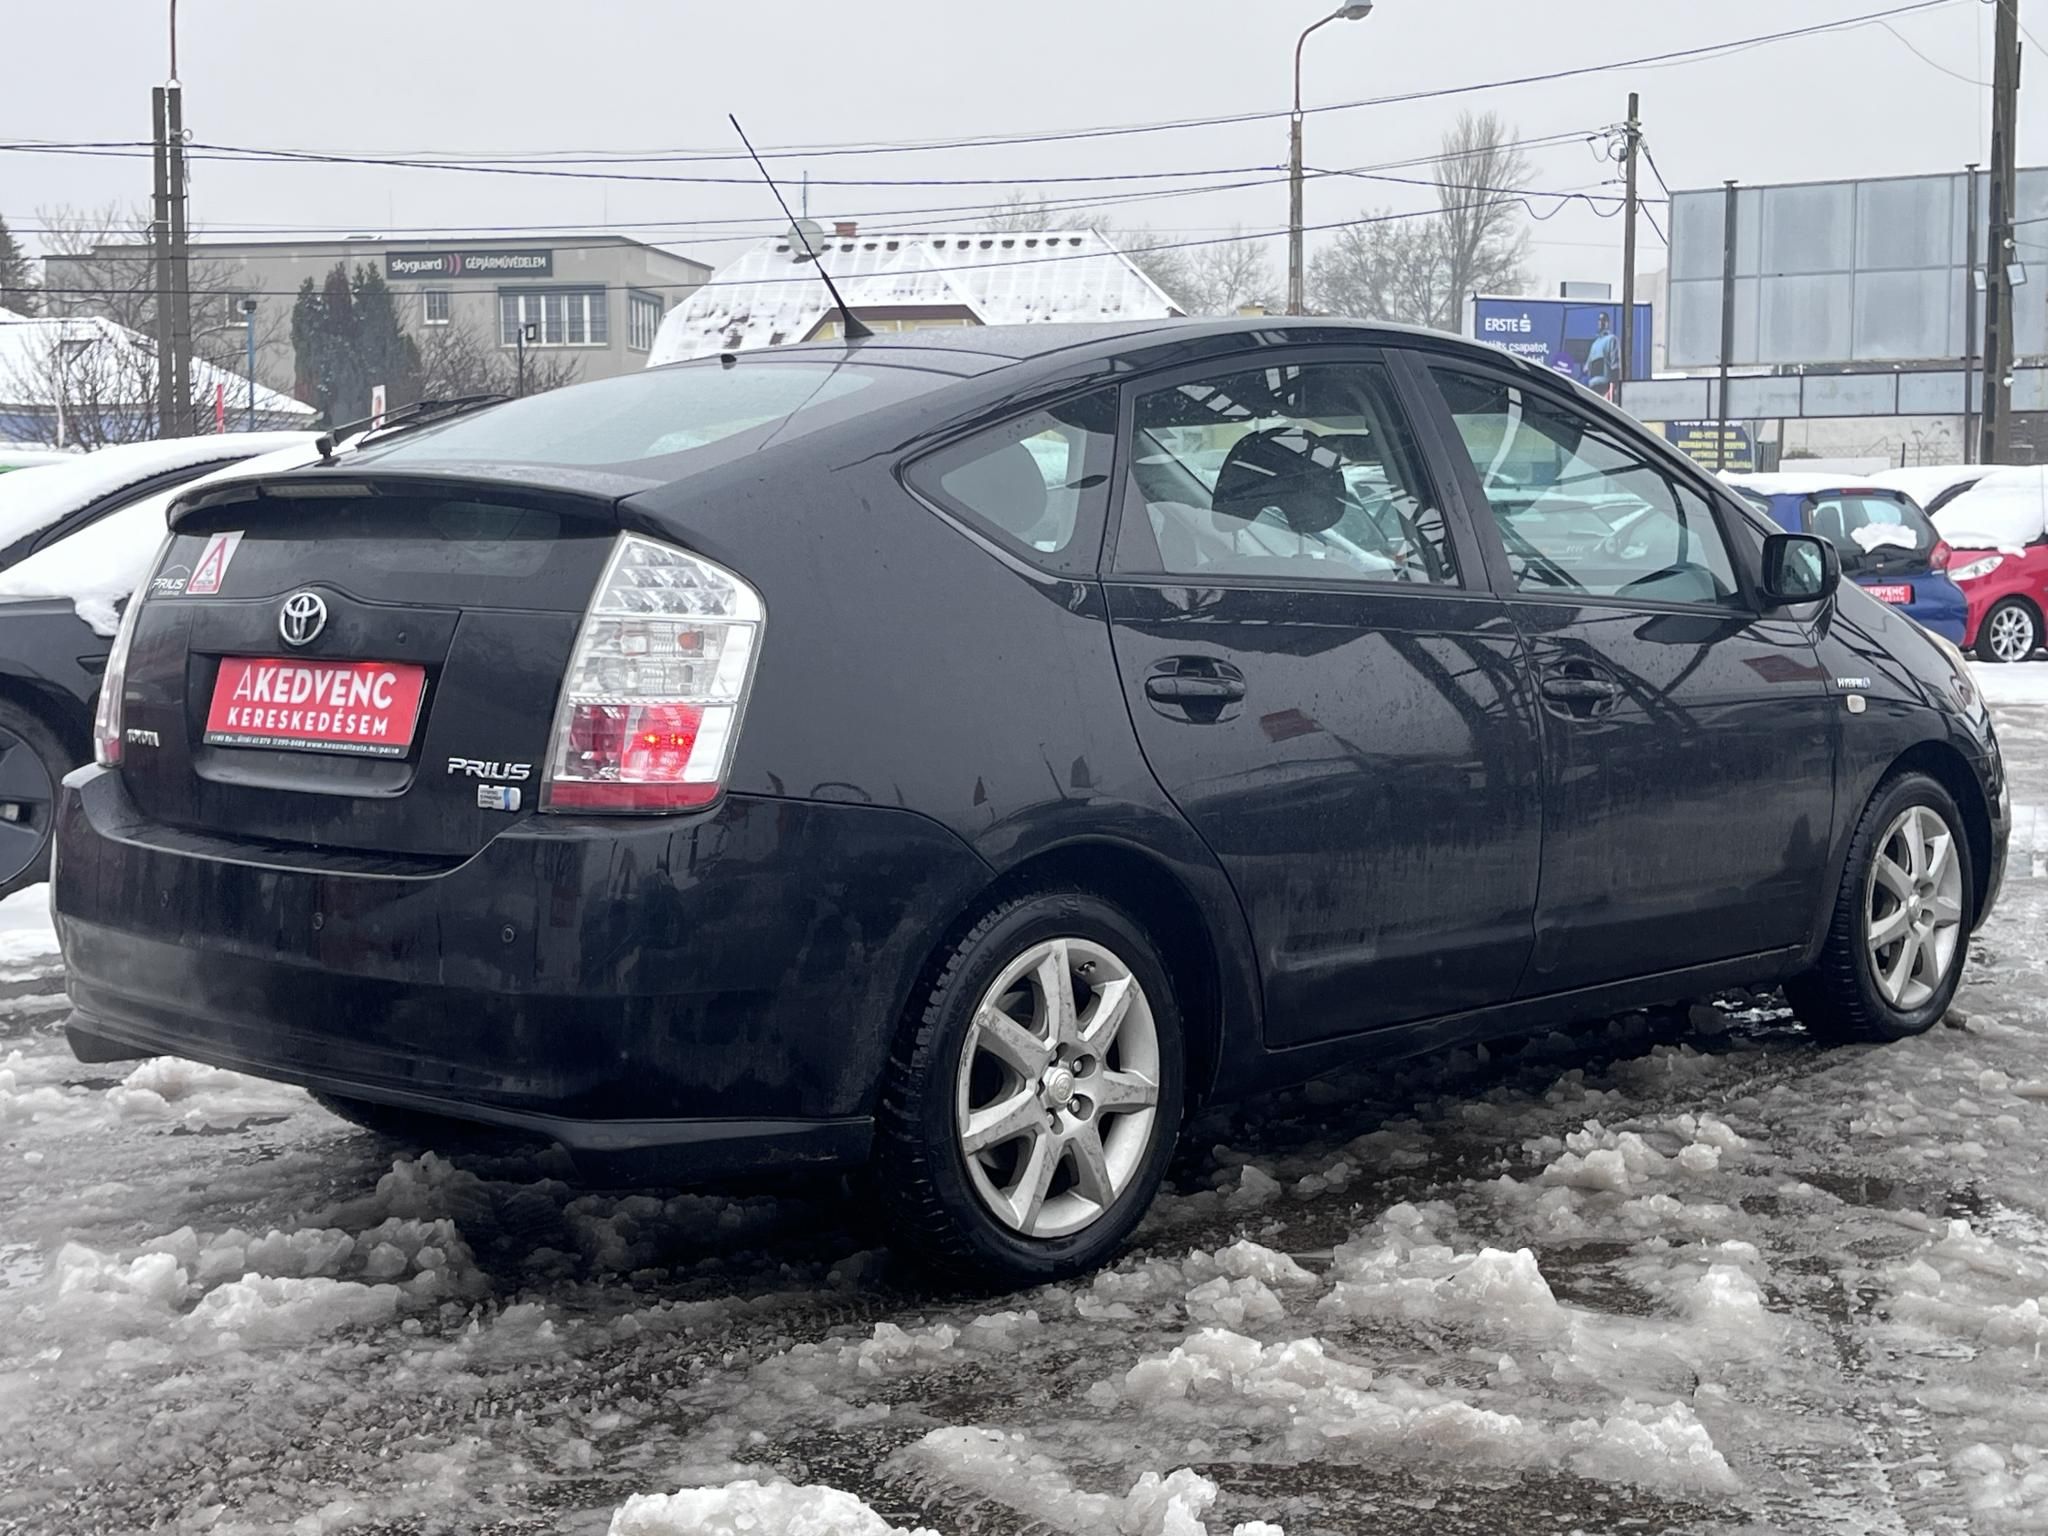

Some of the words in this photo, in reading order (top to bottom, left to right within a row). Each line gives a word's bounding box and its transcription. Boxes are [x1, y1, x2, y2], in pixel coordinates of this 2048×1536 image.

[391, 258, 443, 274] skyguard
[1485, 317, 1519, 332] ERSTE
[151, 577, 187, 590] PRIUS
[227, 706, 389, 737] KERESKEDÉSEM
[447, 756, 533, 781] PRIUS
